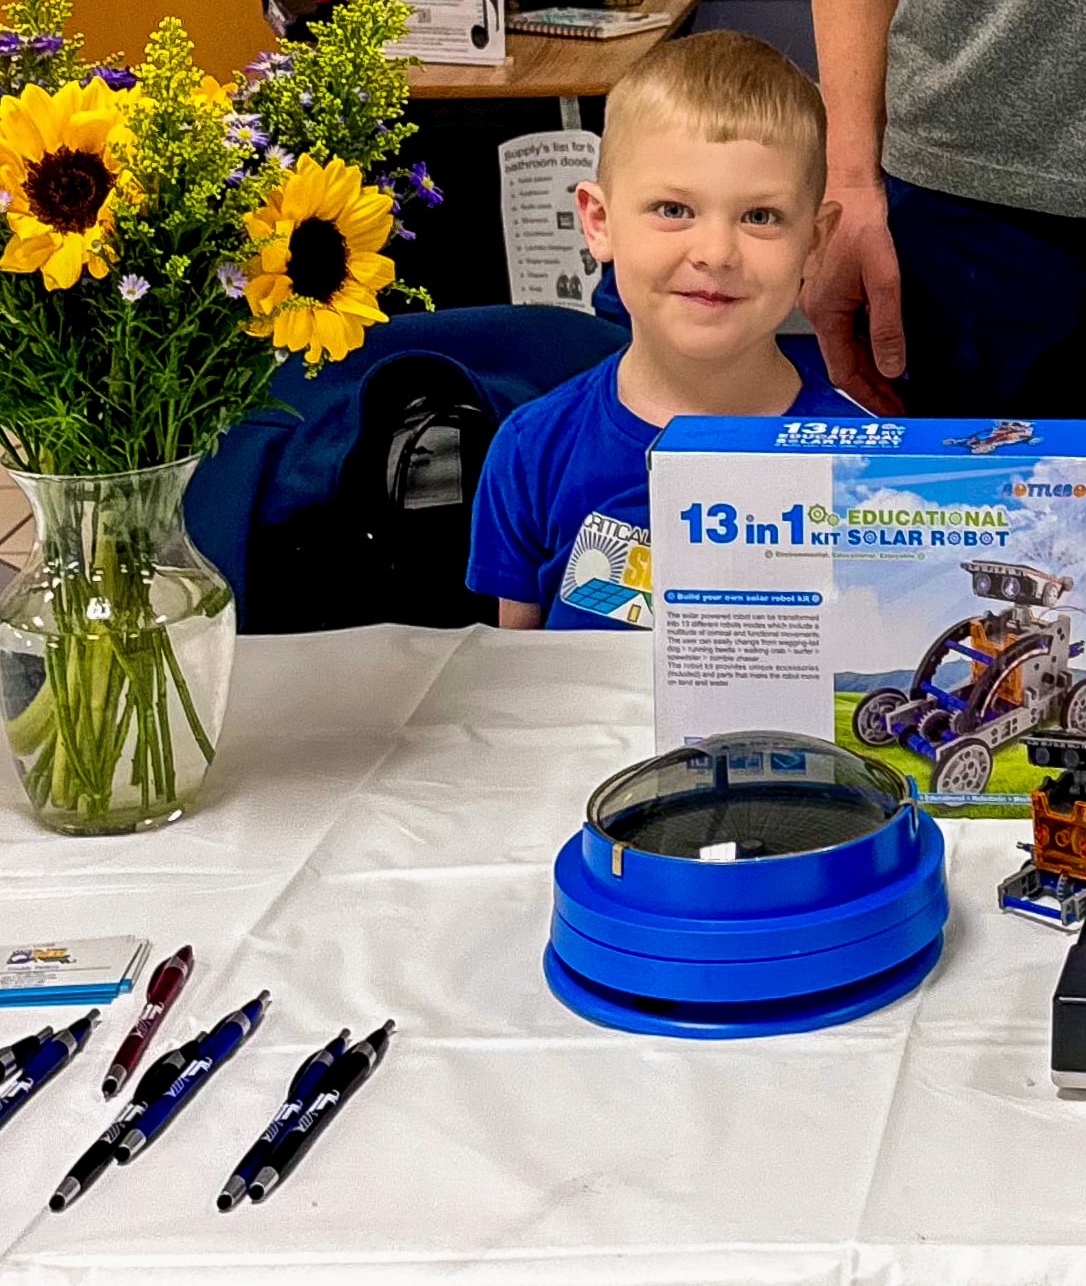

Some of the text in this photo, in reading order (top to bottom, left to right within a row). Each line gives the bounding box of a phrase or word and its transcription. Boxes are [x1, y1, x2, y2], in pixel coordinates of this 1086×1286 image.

[783, 422, 828, 434] 13
[680, 502, 804, 545] 13 in 1
[848, 509, 1009, 527] EDUCATIONAL
[811, 529, 1010, 547] KIT SOLAR ROBOT
[702, 594, 722, 602] your
